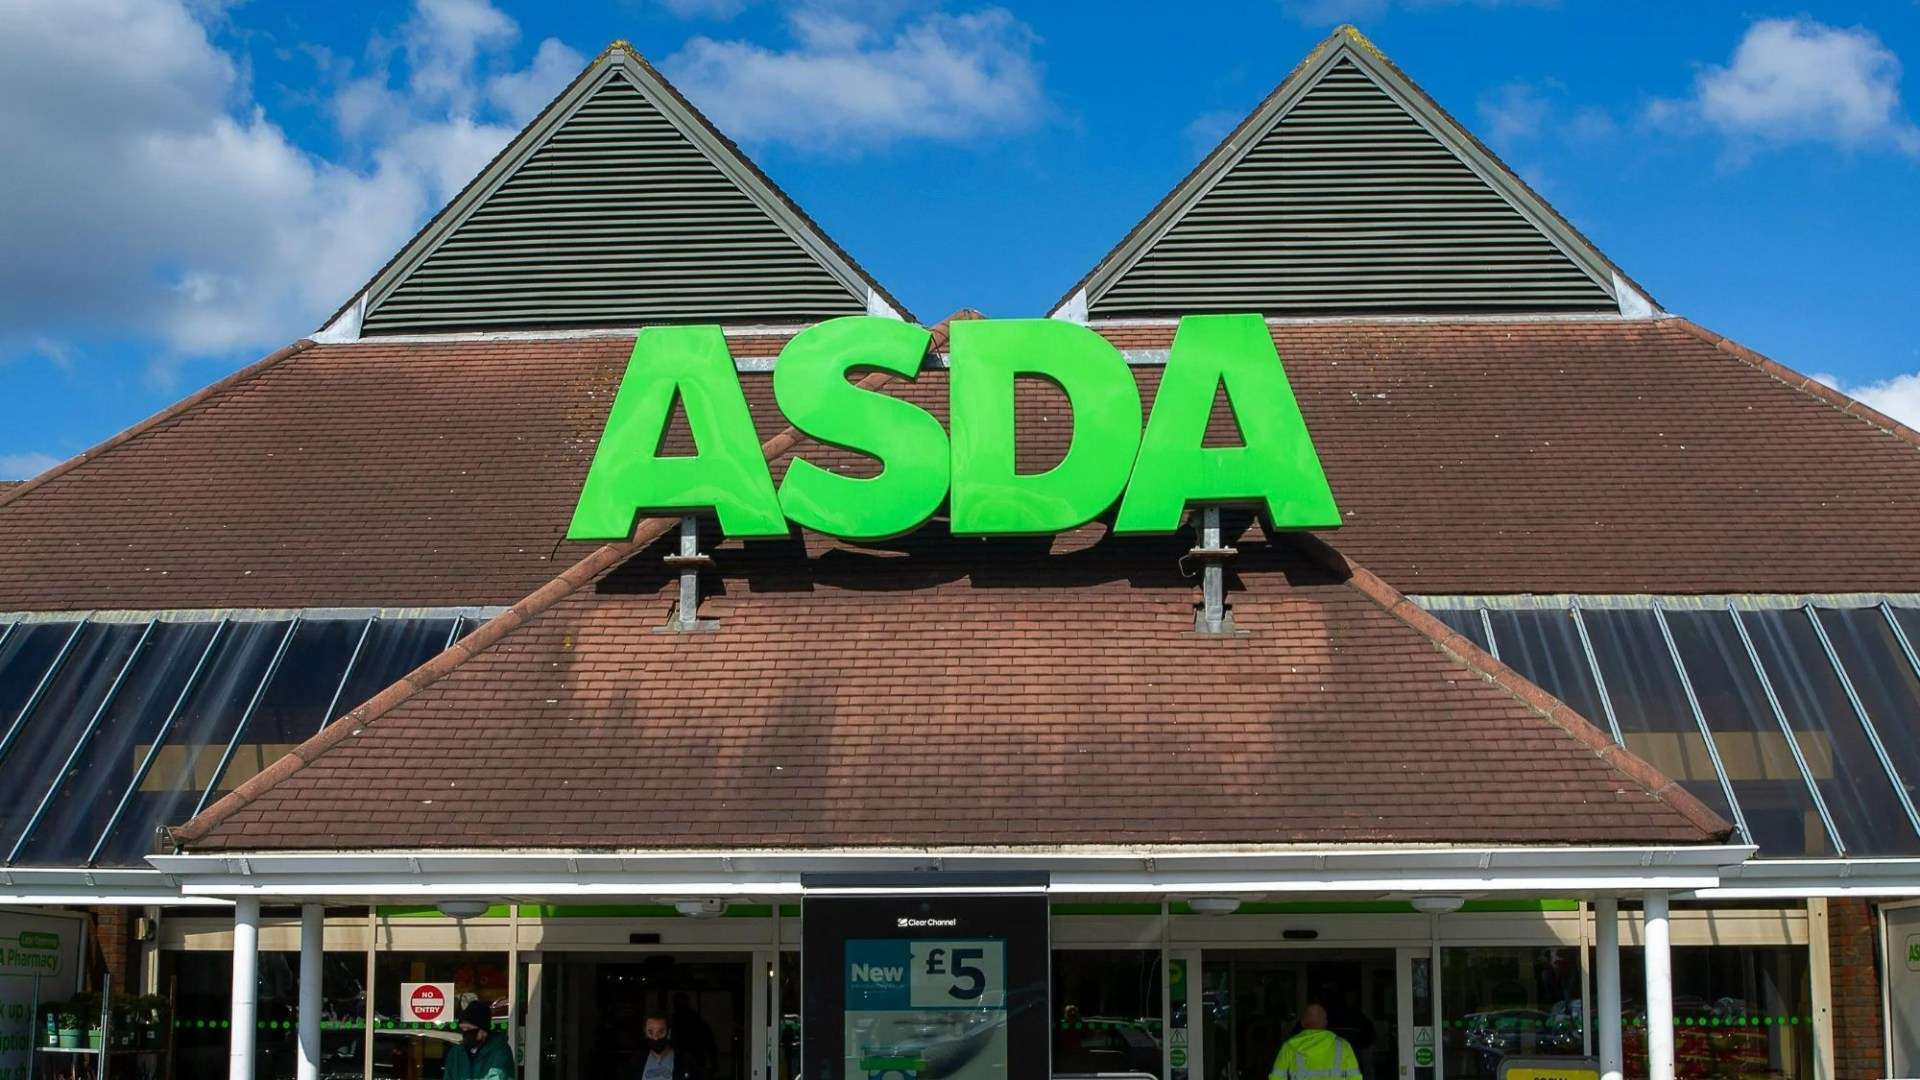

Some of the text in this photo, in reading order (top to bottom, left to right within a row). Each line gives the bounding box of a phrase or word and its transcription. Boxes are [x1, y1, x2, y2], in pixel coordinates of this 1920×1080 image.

[566, 313, 1343, 541] ASDA
[908, 918, 956, 926] Clear Channel
[8, 949, 58, 971] Pharmacy
[851, 963, 904, 983] New
[926, 948, 986, 1000] £5
[414, 1006, 440, 1014] ENTRY
